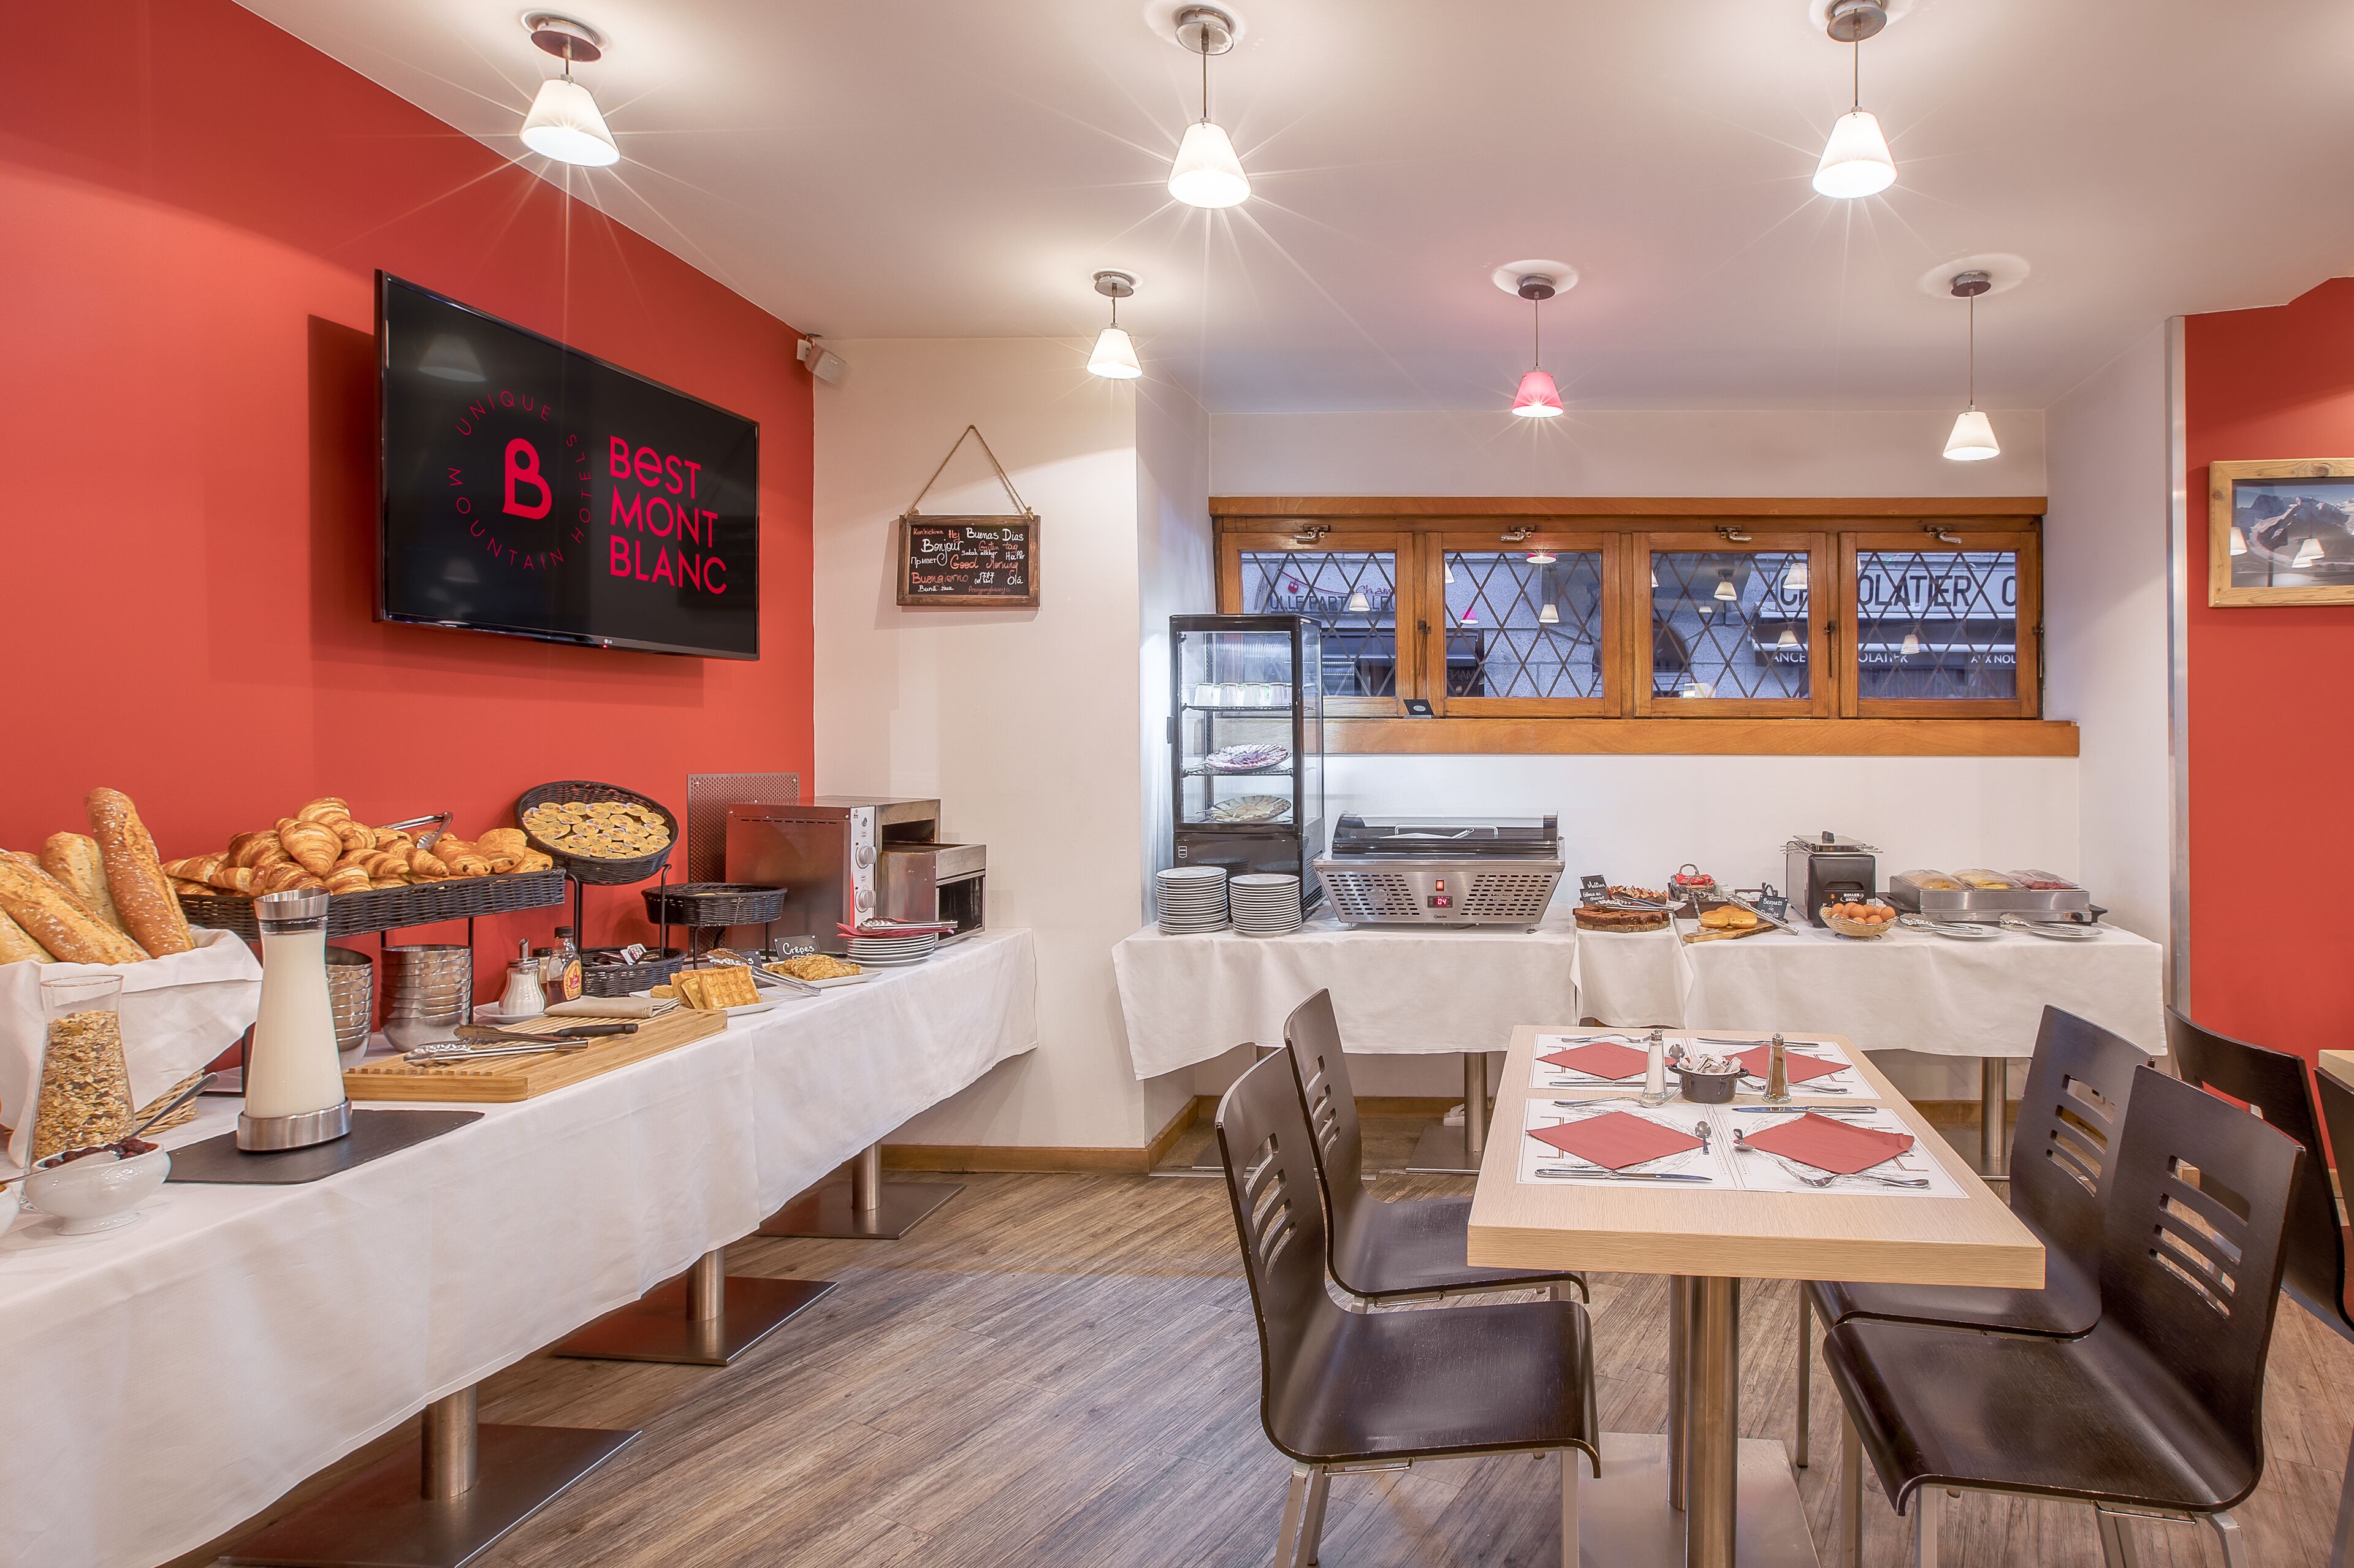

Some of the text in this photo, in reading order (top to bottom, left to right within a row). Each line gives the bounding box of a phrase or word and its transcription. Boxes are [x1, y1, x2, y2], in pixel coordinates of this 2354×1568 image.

[456, 390, 550, 436] UNIQUE
[448, 434, 593, 571] MOUNTAIN HOTELS
[610, 483, 719, 549] MONT
[966, 527, 1024, 542] Buenas Dias
[921, 538, 964, 566] Bonjour
[978, 540, 999, 551] Guten
[609, 534, 728, 595] BLANC
[910, 557, 937, 569] Привет
[950, 554, 979, 569] Good
[911, 572, 969, 586] Buongiorno
[1007, 575, 1024, 585] Olá
[782, 942, 815, 955] Crêpes
